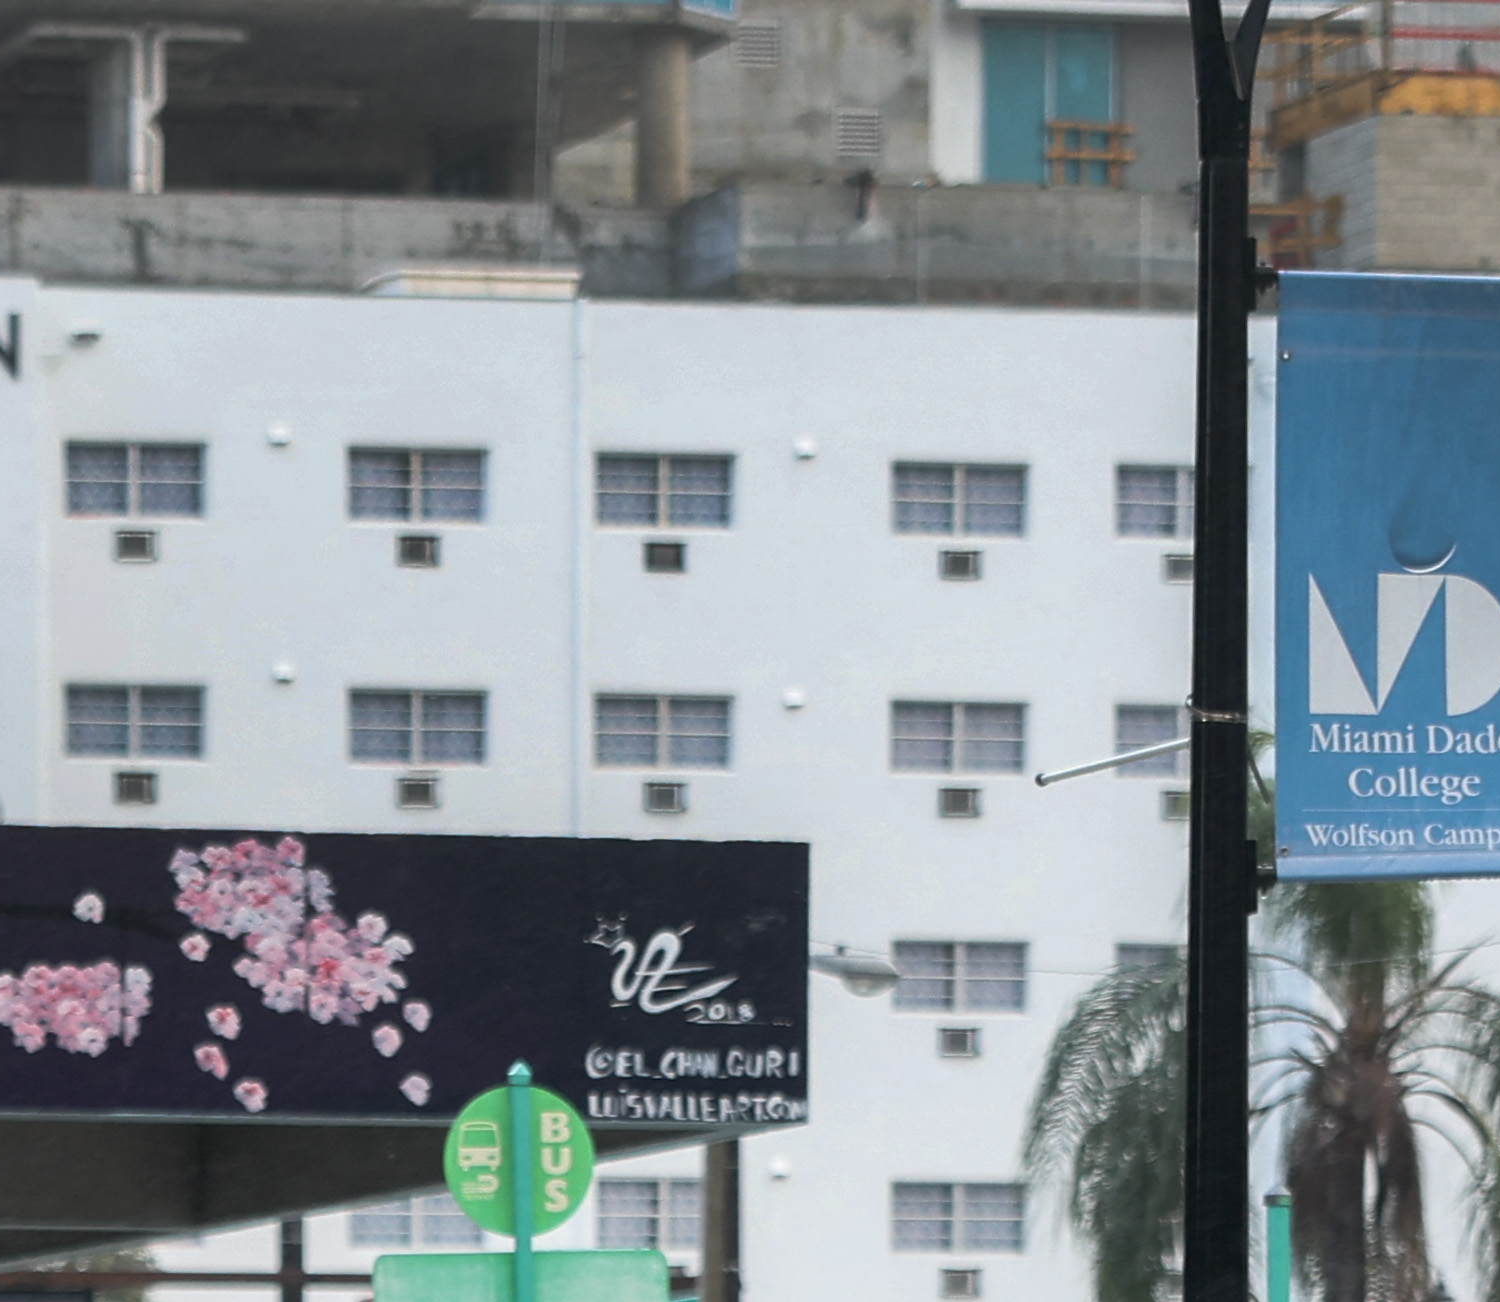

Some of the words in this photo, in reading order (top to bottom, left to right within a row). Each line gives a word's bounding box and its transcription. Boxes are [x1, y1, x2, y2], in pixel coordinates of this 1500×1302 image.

[1308, 723, 1416, 755] Miami
[1347, 767, 1482, 805] College
[1305, 822, 1415, 848] Wolfson
[540, 1112, 573, 1214] BUS
